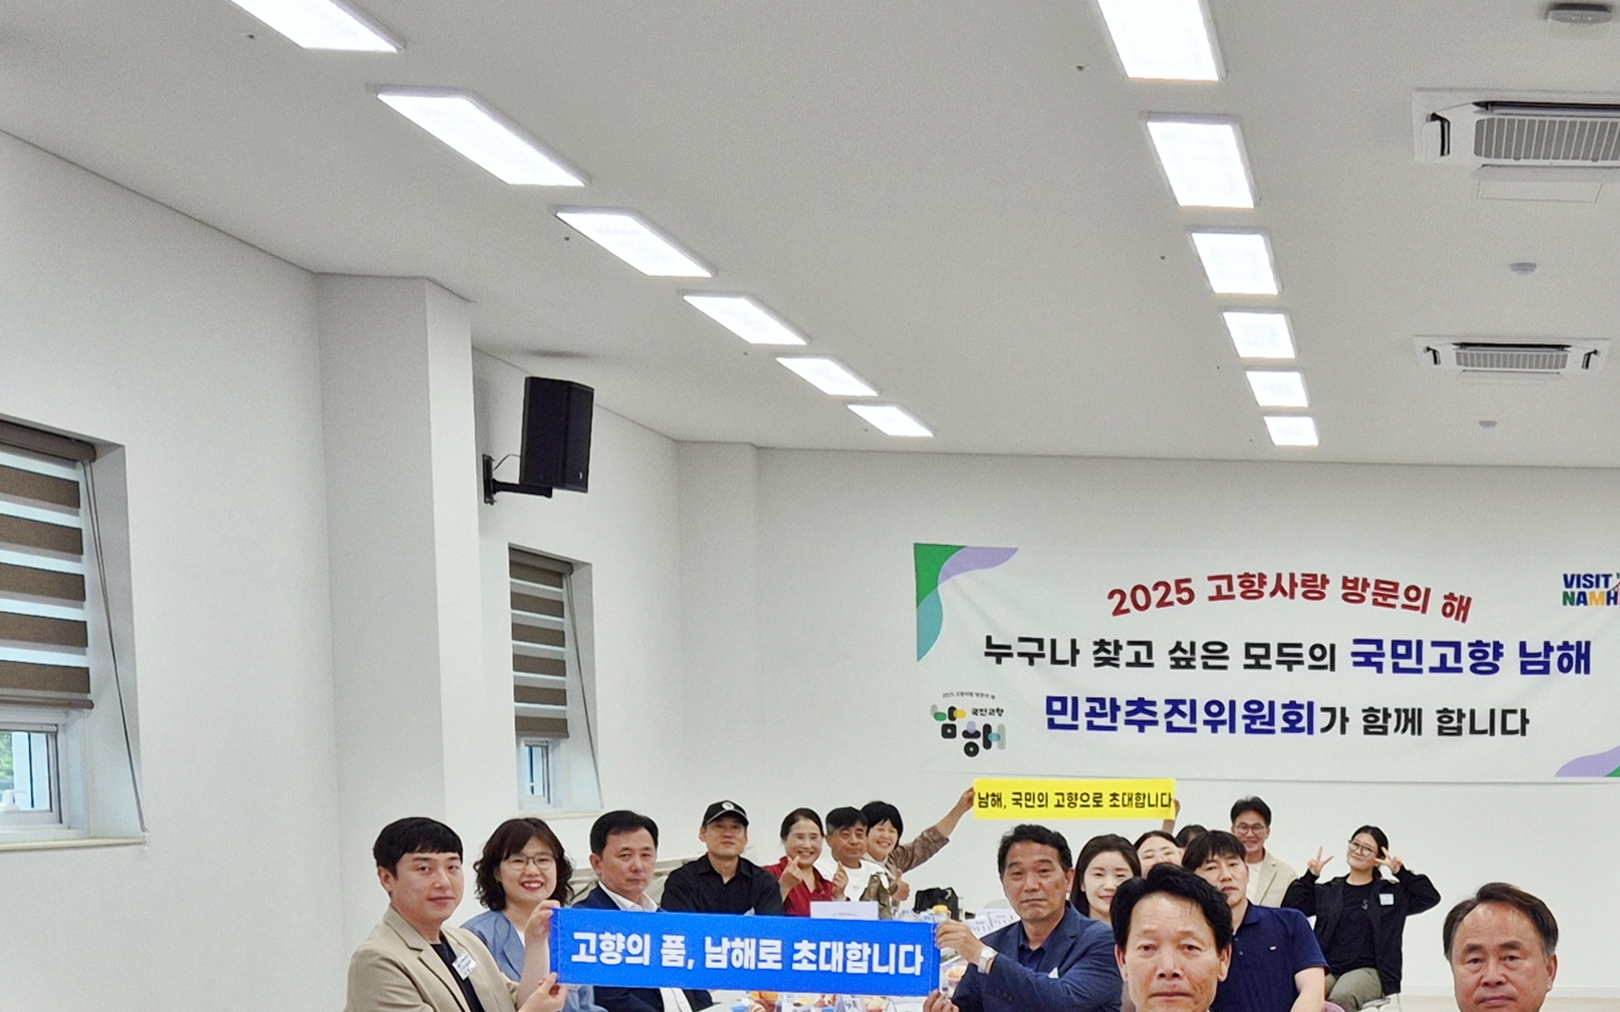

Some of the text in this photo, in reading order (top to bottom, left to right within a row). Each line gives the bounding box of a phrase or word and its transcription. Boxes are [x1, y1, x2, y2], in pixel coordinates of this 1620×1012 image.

[1106, 571, 1474, 624] 2025 고향사랑 방문의 해
[1562, 573, 1613, 589] VISIT
[983, 634, 1592, 676] 누구나 찾고 싶은 모두의 국민고향 남해
[971, 706, 1004, 718] 국민고향
[1045, 694, 1530, 738] 민관추진위원회가 함께 합니다
[977, 791, 1173, 810] 남해, 국민의 고향으로 초대합니다
[571, 930, 925, 977] 고향의 품, 남해로 초대합니다
